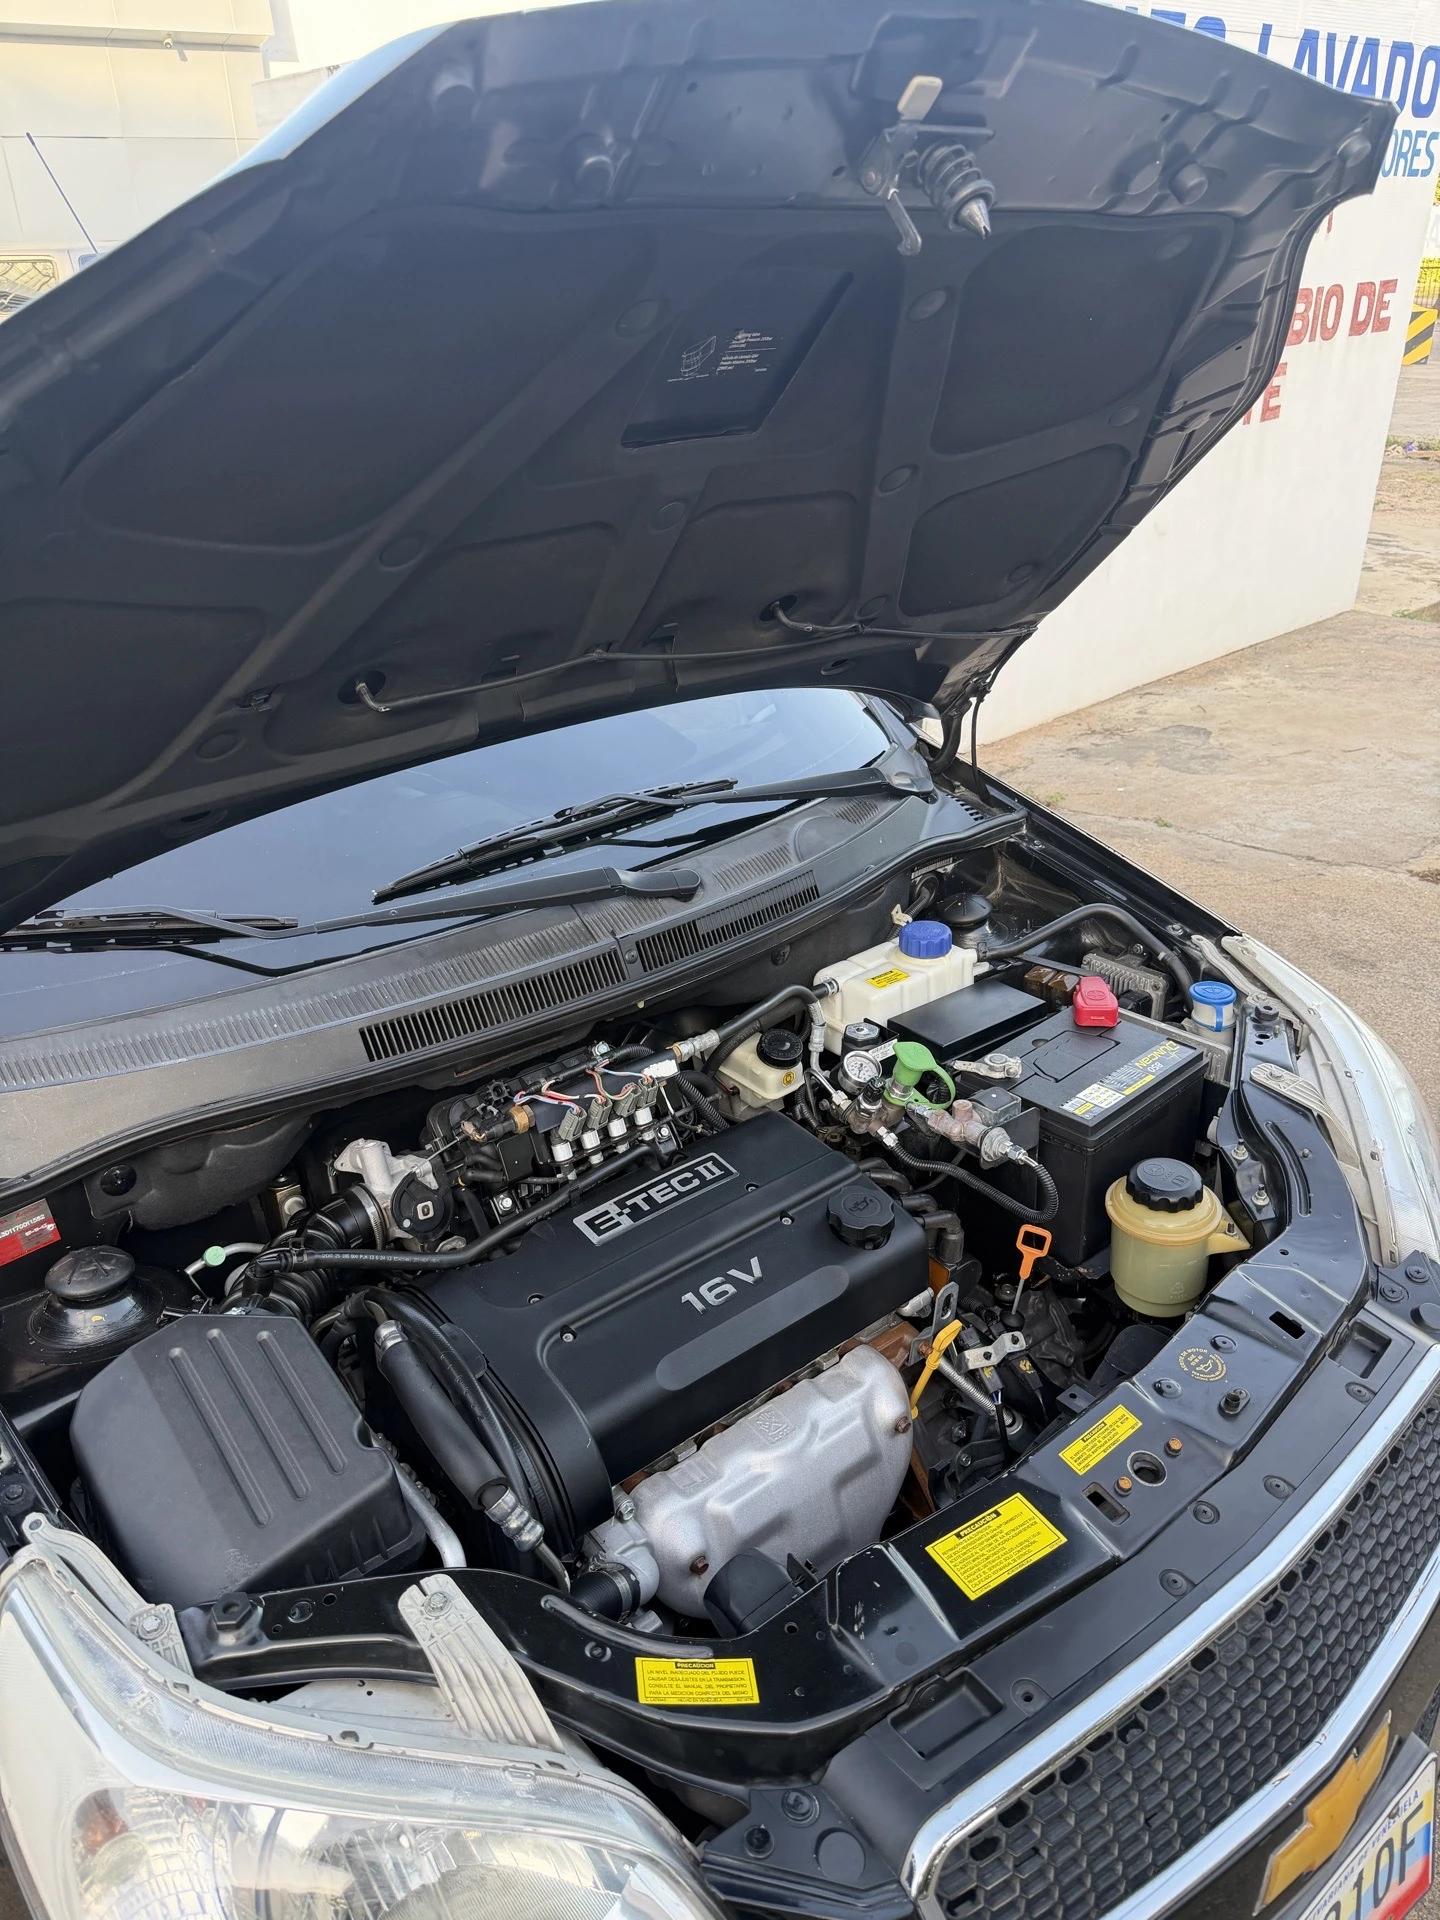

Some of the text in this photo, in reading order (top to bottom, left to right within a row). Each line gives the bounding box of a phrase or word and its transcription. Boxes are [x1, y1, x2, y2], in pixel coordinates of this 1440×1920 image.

[1284, 278, 1398, 346] BIO DE
[1243, 362, 1288, 425] E
[1147, 1061, 1163, 1073] 850
[681, 1256, 763, 1314] 16V
[1322, 1800, 1424, 1920] 10F
